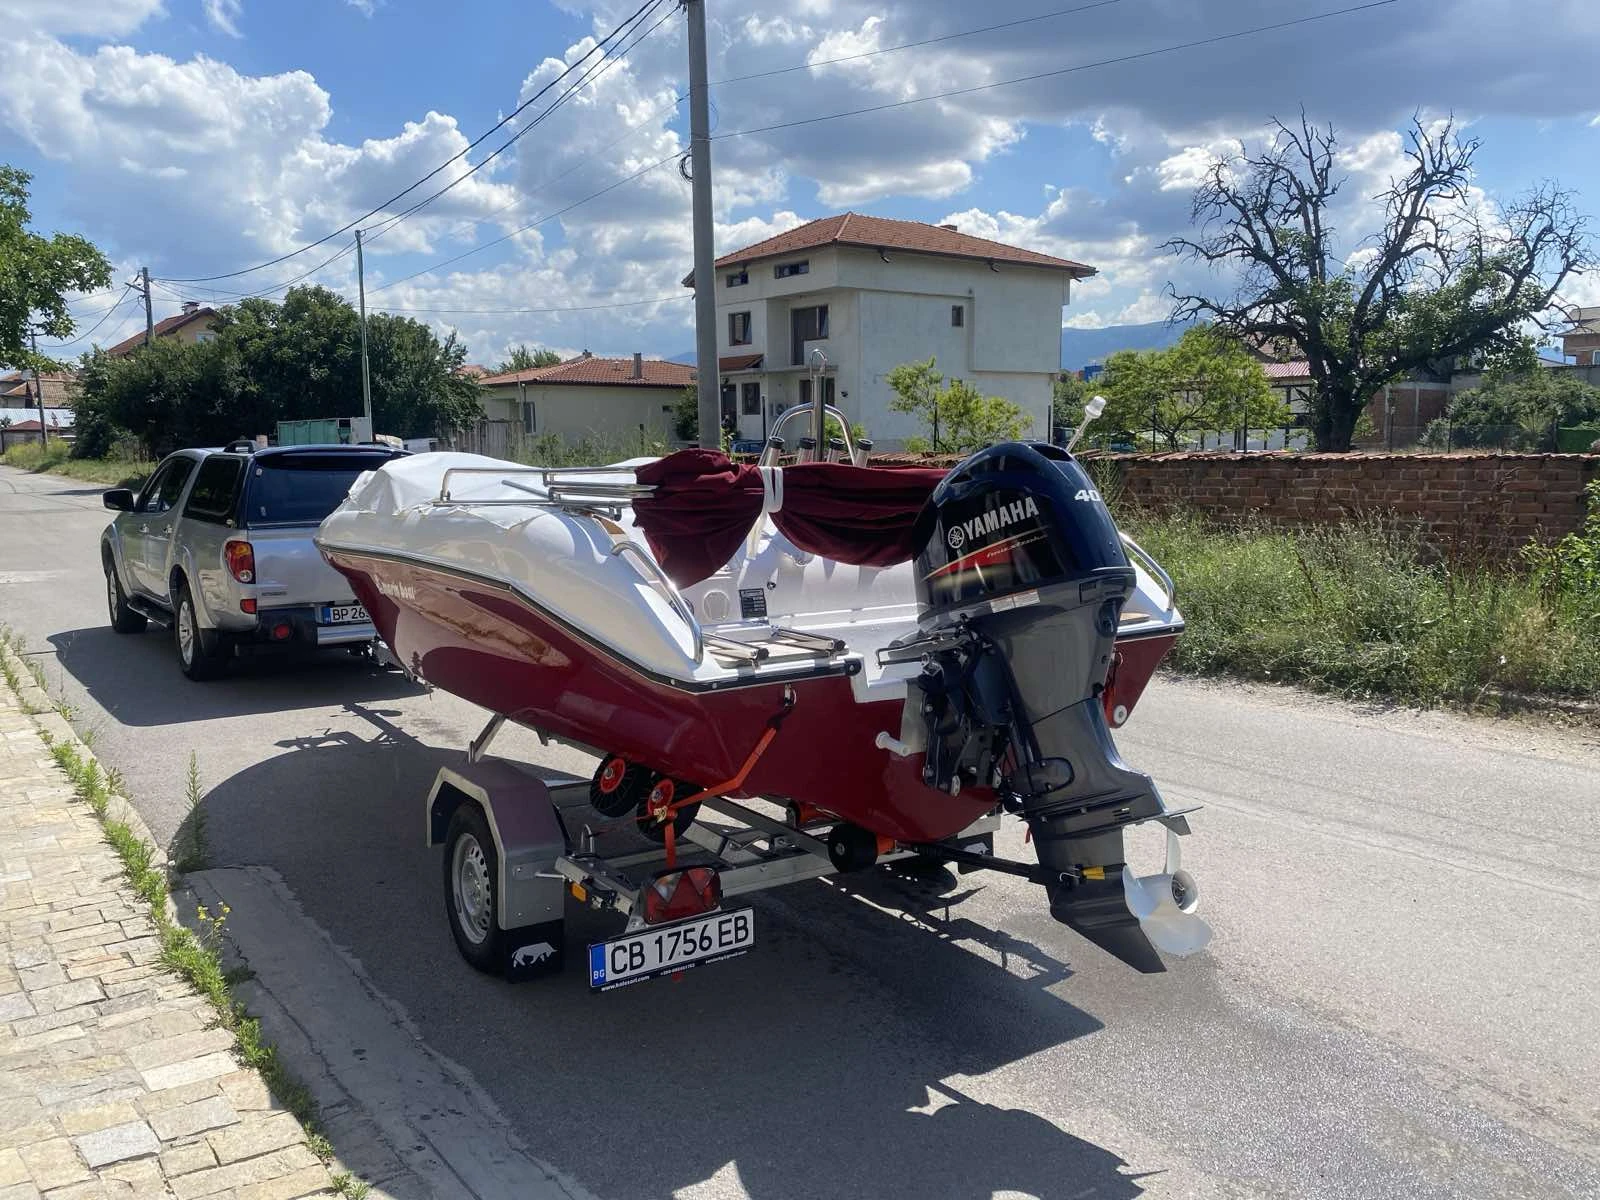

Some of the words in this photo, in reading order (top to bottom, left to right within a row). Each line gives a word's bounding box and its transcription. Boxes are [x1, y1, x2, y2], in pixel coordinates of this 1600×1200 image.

[1074, 489, 1101, 502] 40
[963, 496, 1040, 541] YAMAHA
[333, 608, 349, 621] BP
[610, 941, 646, 975] CB
[654, 925, 713, 964] 1756
[718, 915, 749, 948] EB
[593, 970, 606, 980] BG
